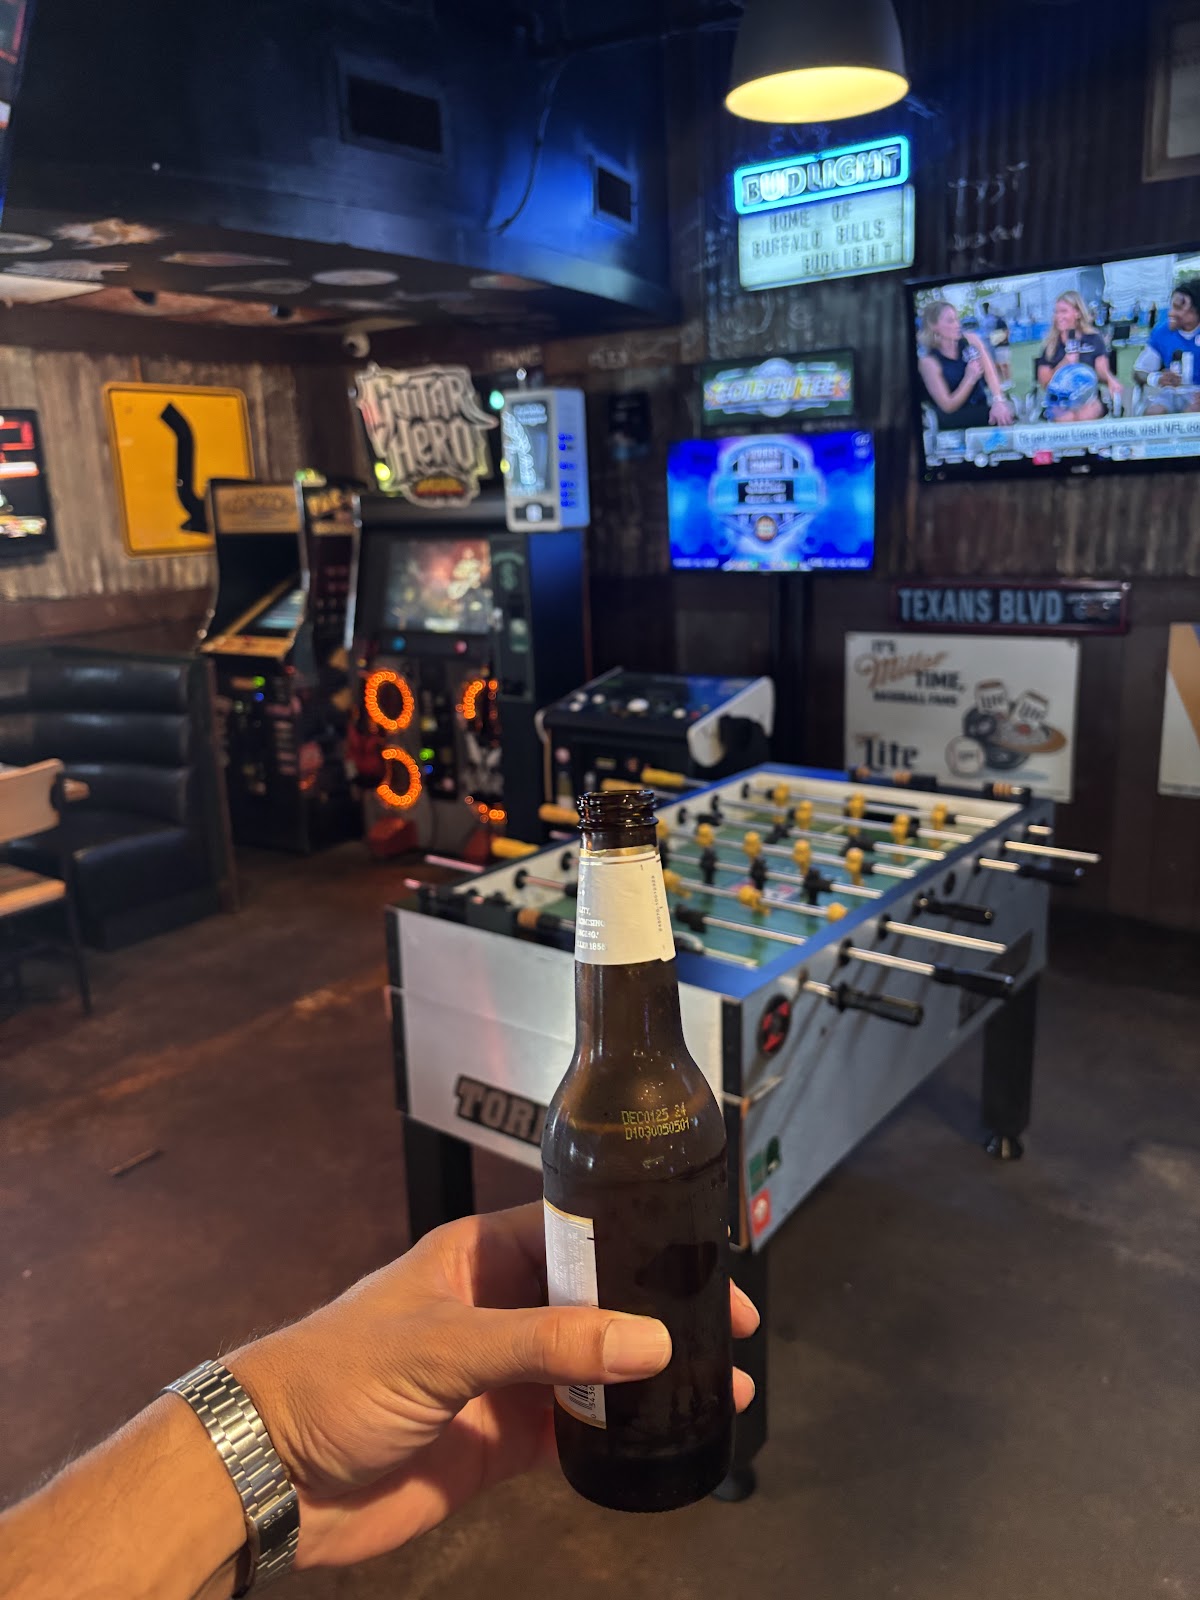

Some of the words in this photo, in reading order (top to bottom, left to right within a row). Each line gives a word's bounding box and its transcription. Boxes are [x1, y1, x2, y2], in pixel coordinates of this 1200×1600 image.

[769, 210, 809, 234] HOME
[831, 202, 852, 222] OF
[752, 231, 822, 259] BUFFALO
[836, 219, 884, 244] BILLS
[899, 589, 992, 622] TEXANS
[1001, 591, 1063, 625] BLVD
[855, 733, 918, 771] Lite
